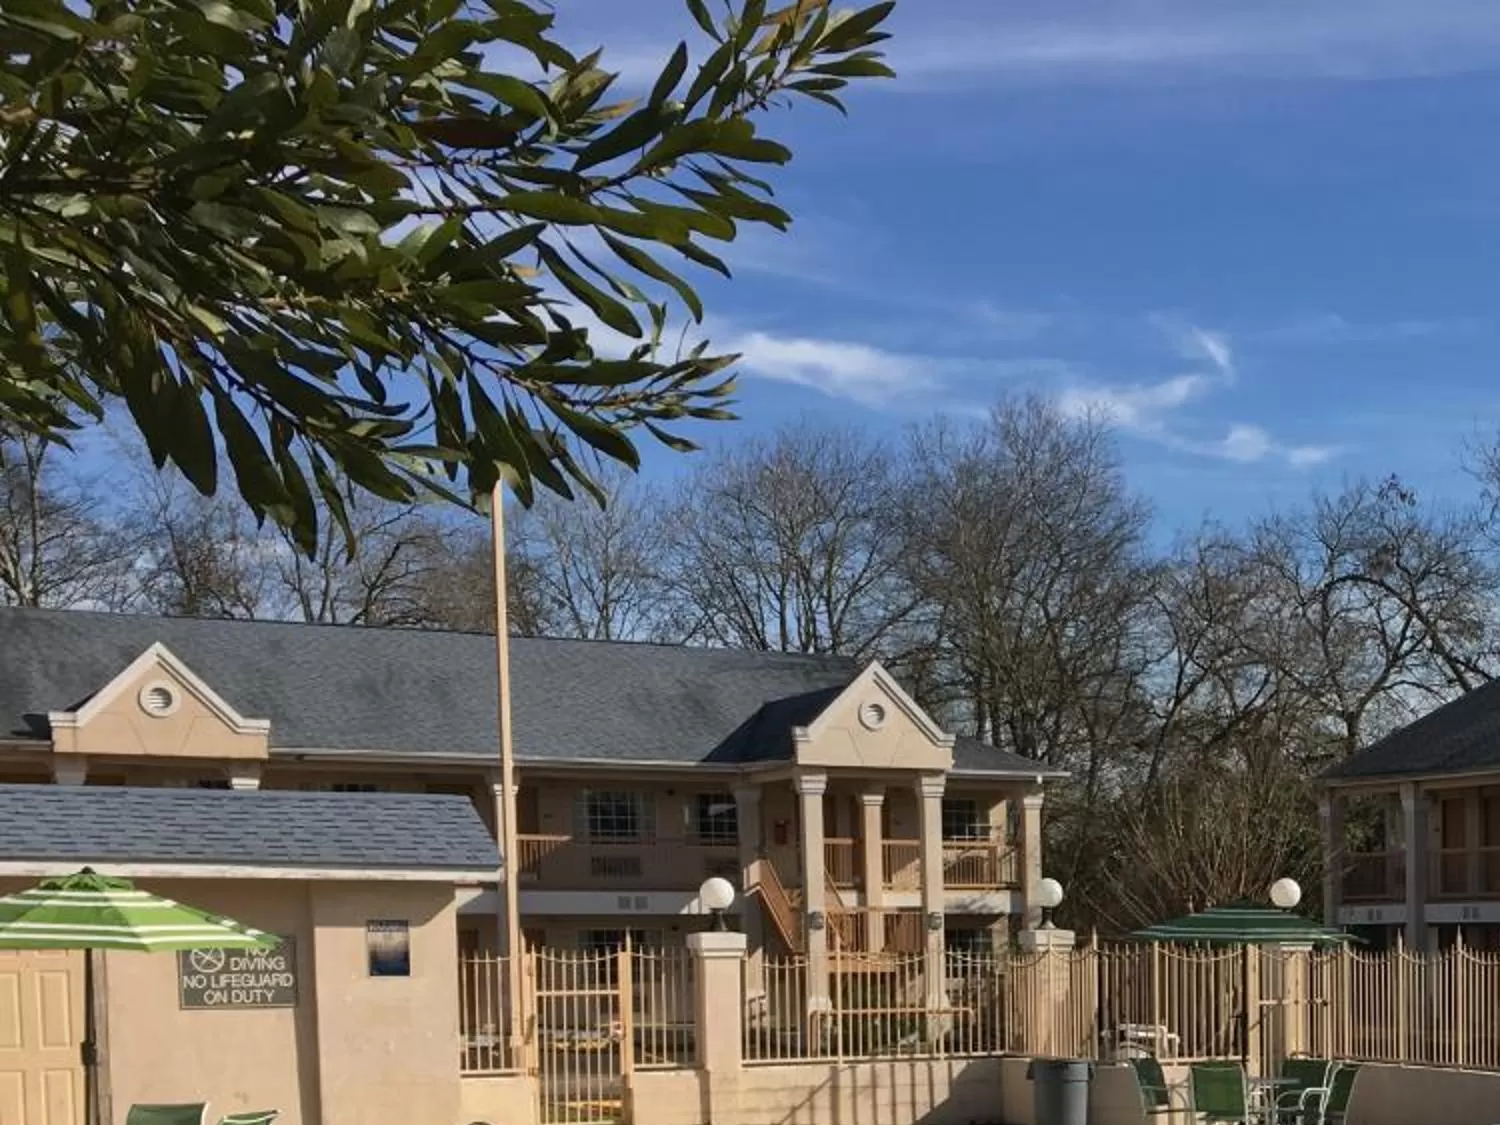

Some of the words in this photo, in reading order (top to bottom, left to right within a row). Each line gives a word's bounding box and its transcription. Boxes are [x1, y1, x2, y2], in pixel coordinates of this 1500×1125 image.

[229, 956, 286, 971] DIVING
[183, 974, 207, 989] NO
[211, 972, 293, 988] LIFEGUARD
[203, 990, 227, 1005] ON
[231, 989, 275, 1003] DUTY
